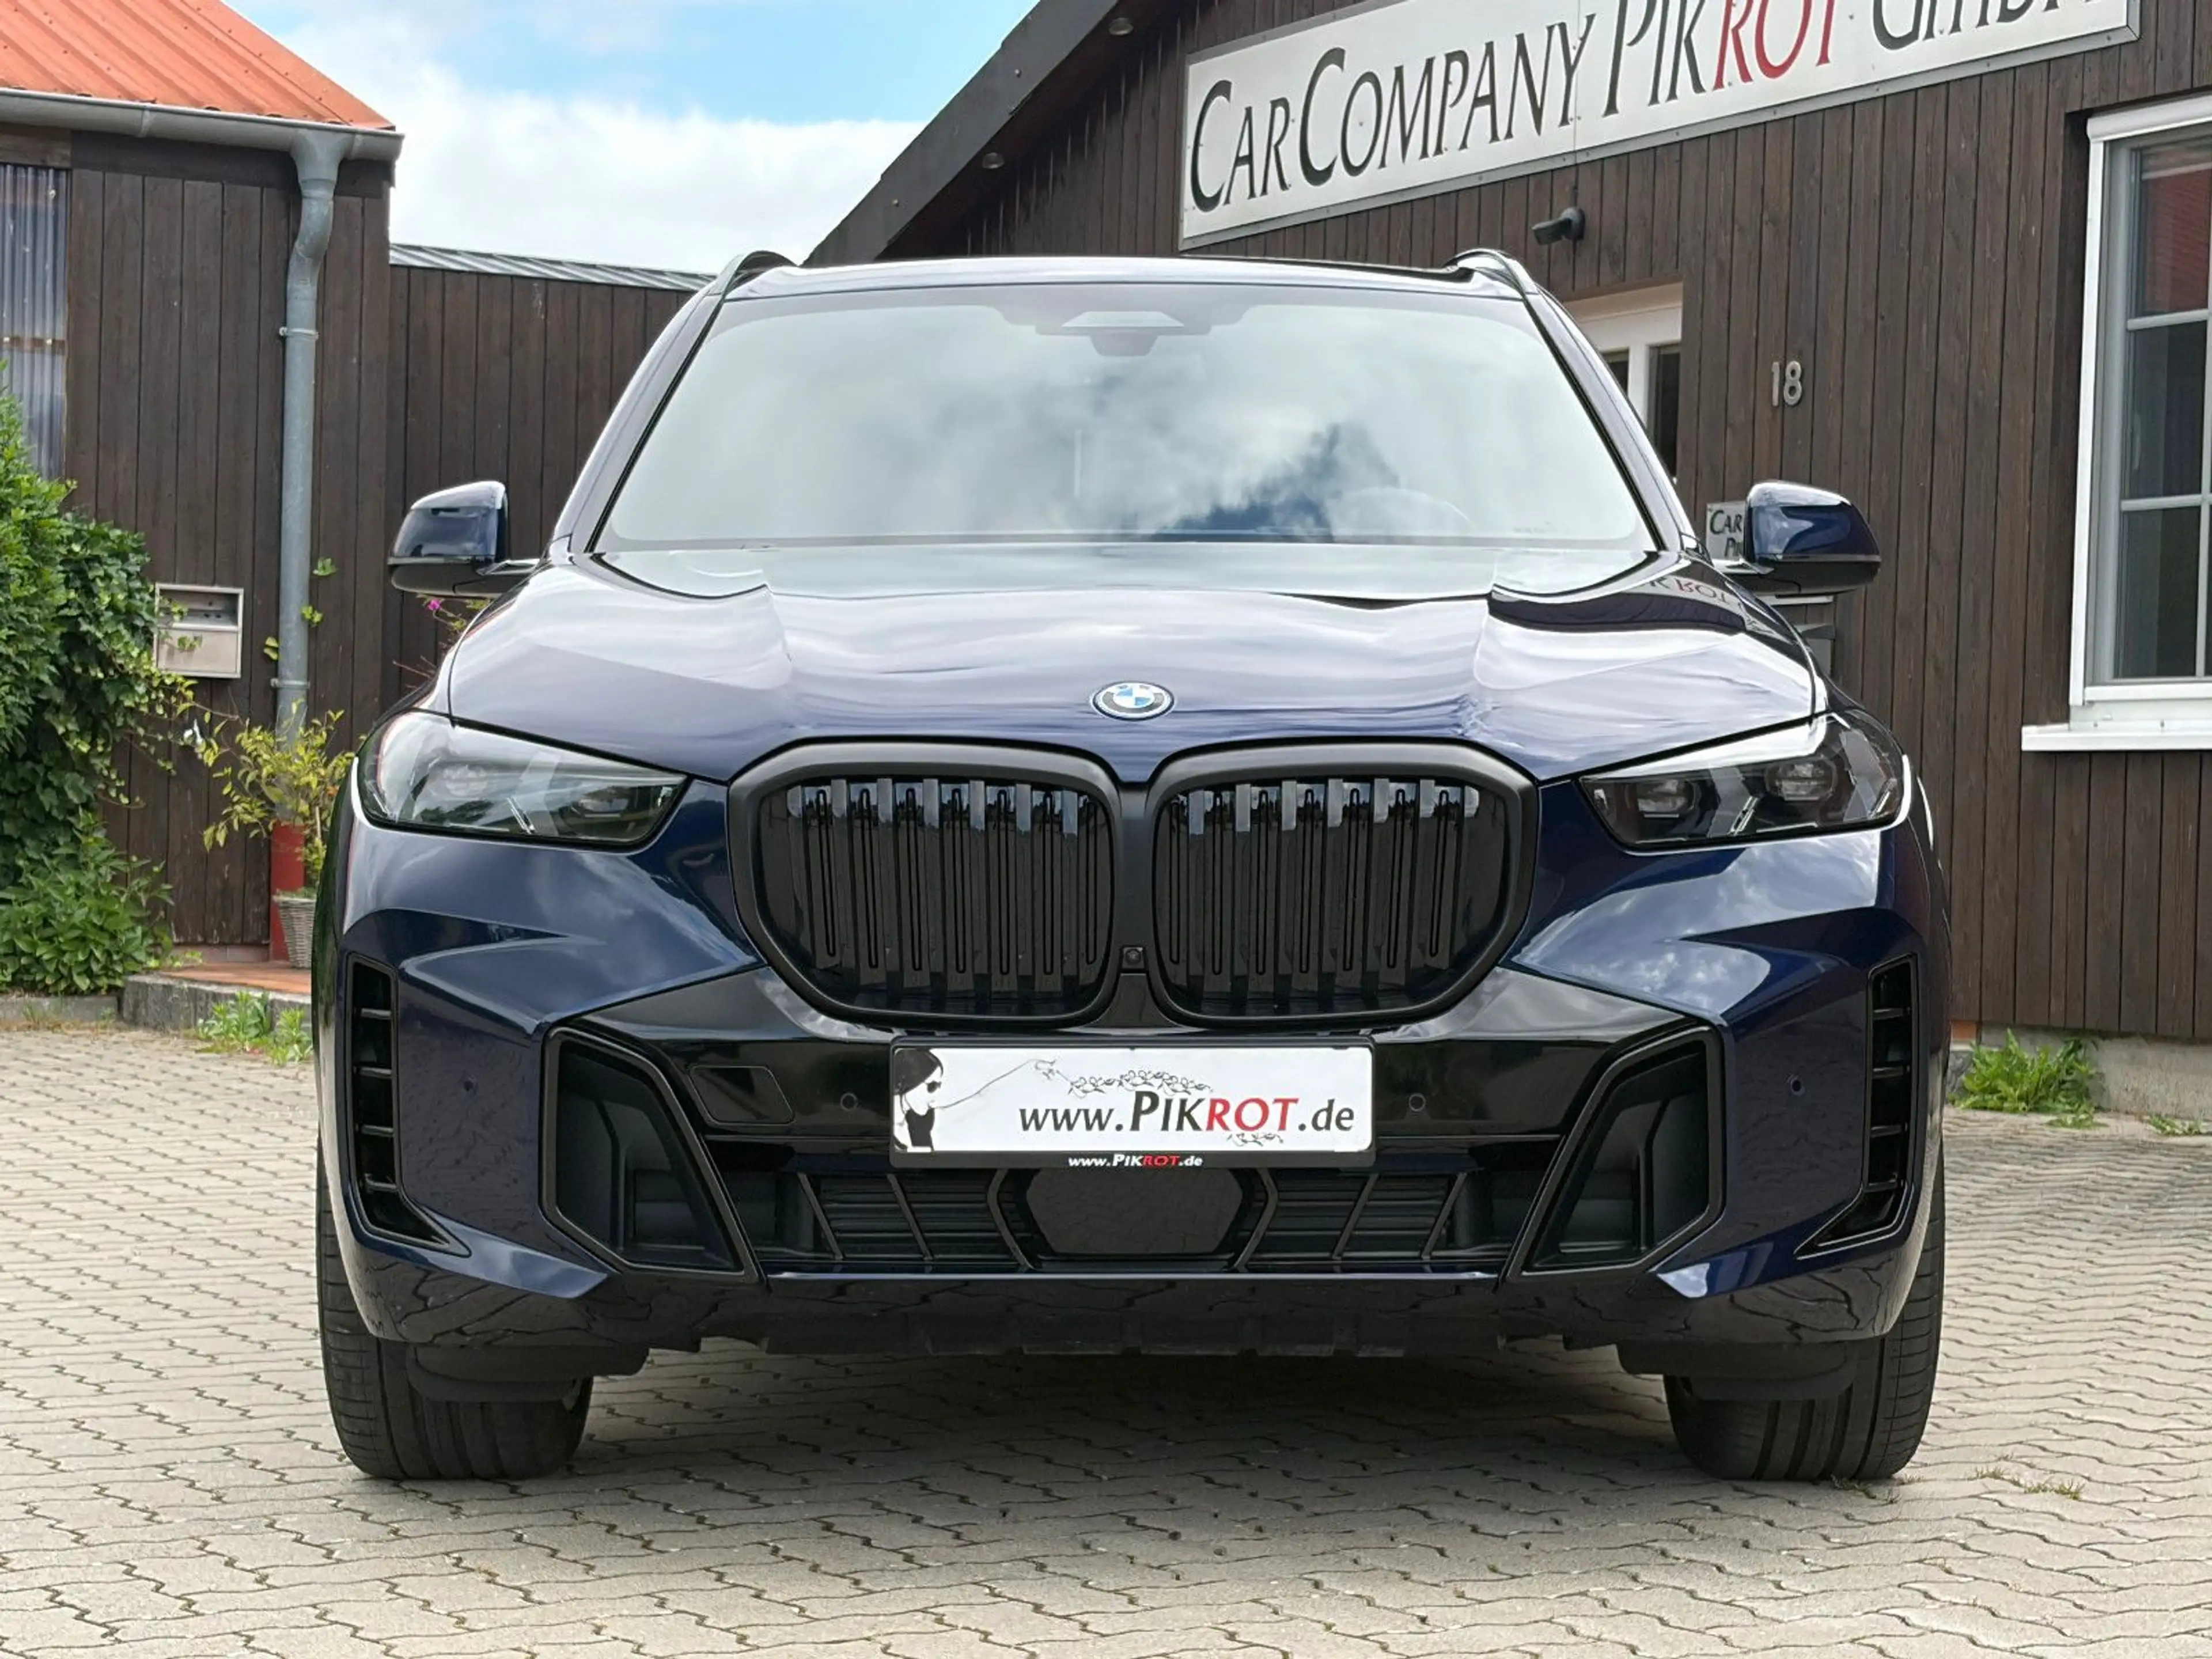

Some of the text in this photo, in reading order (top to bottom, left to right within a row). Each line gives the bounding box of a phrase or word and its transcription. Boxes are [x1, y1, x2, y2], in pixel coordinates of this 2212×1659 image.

[1771, 361, 1802, 406] 18
[1019, 1090, 1355, 1131] www.PIKROT.de
[1067, 1153, 1204, 1167] www.PIKROT.de
